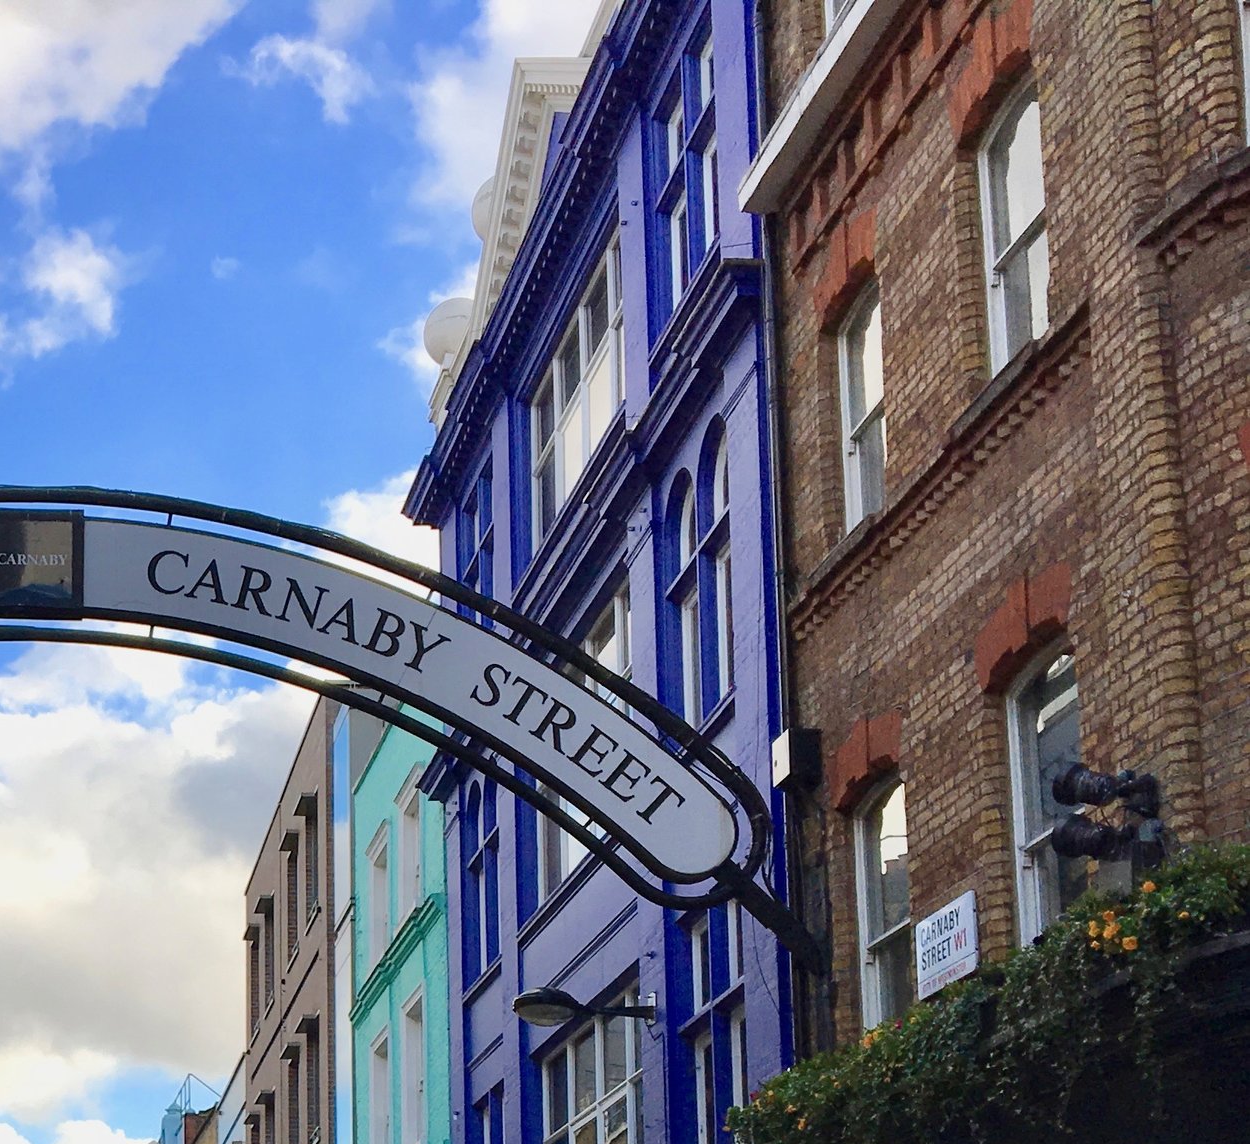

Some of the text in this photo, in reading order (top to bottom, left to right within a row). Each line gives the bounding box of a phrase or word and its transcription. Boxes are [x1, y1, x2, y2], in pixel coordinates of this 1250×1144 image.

[147, 549, 686, 826] CARNABY STREET
[920, 906, 961, 948] CARNABY
[922, 927, 967, 971] STREET W1
